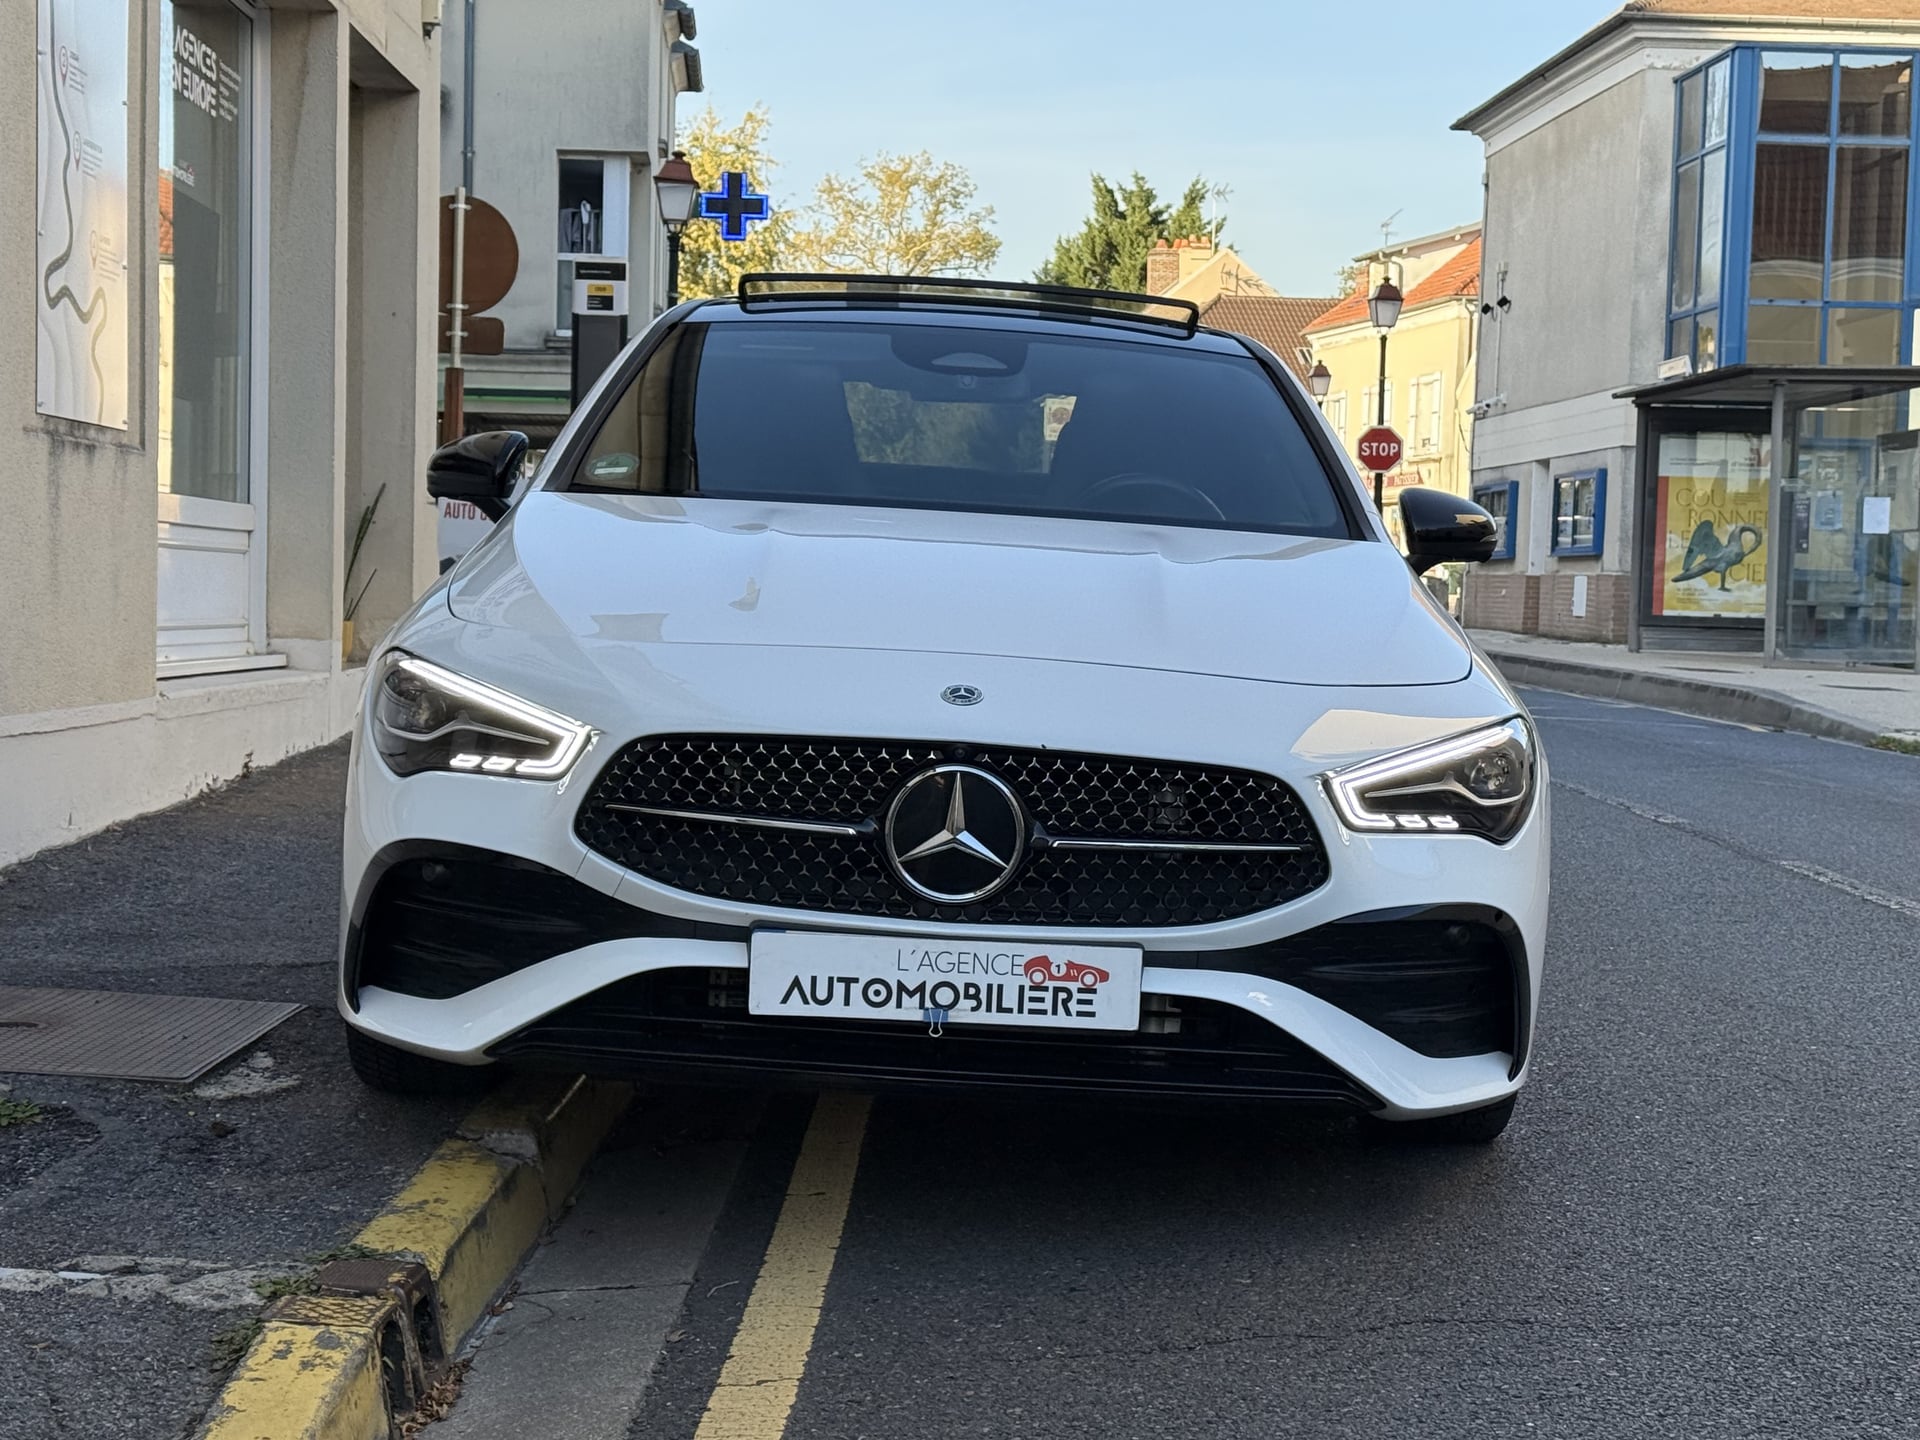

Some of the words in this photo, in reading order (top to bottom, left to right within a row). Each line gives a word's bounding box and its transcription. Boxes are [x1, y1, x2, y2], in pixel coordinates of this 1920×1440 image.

[174, 25, 217, 82] AGENCES
[183, 66, 217, 118] EUROPE
[1360, 442, 1399, 456] STOP
[1676, 488, 1726, 508] COU
[444, 502, 476, 520] AUTO
[1669, 530, 1691, 548] LE
[897, 948, 1025, 976] L'AGENCE
[780, 974, 1098, 1018] AUTOMOBILIERE
